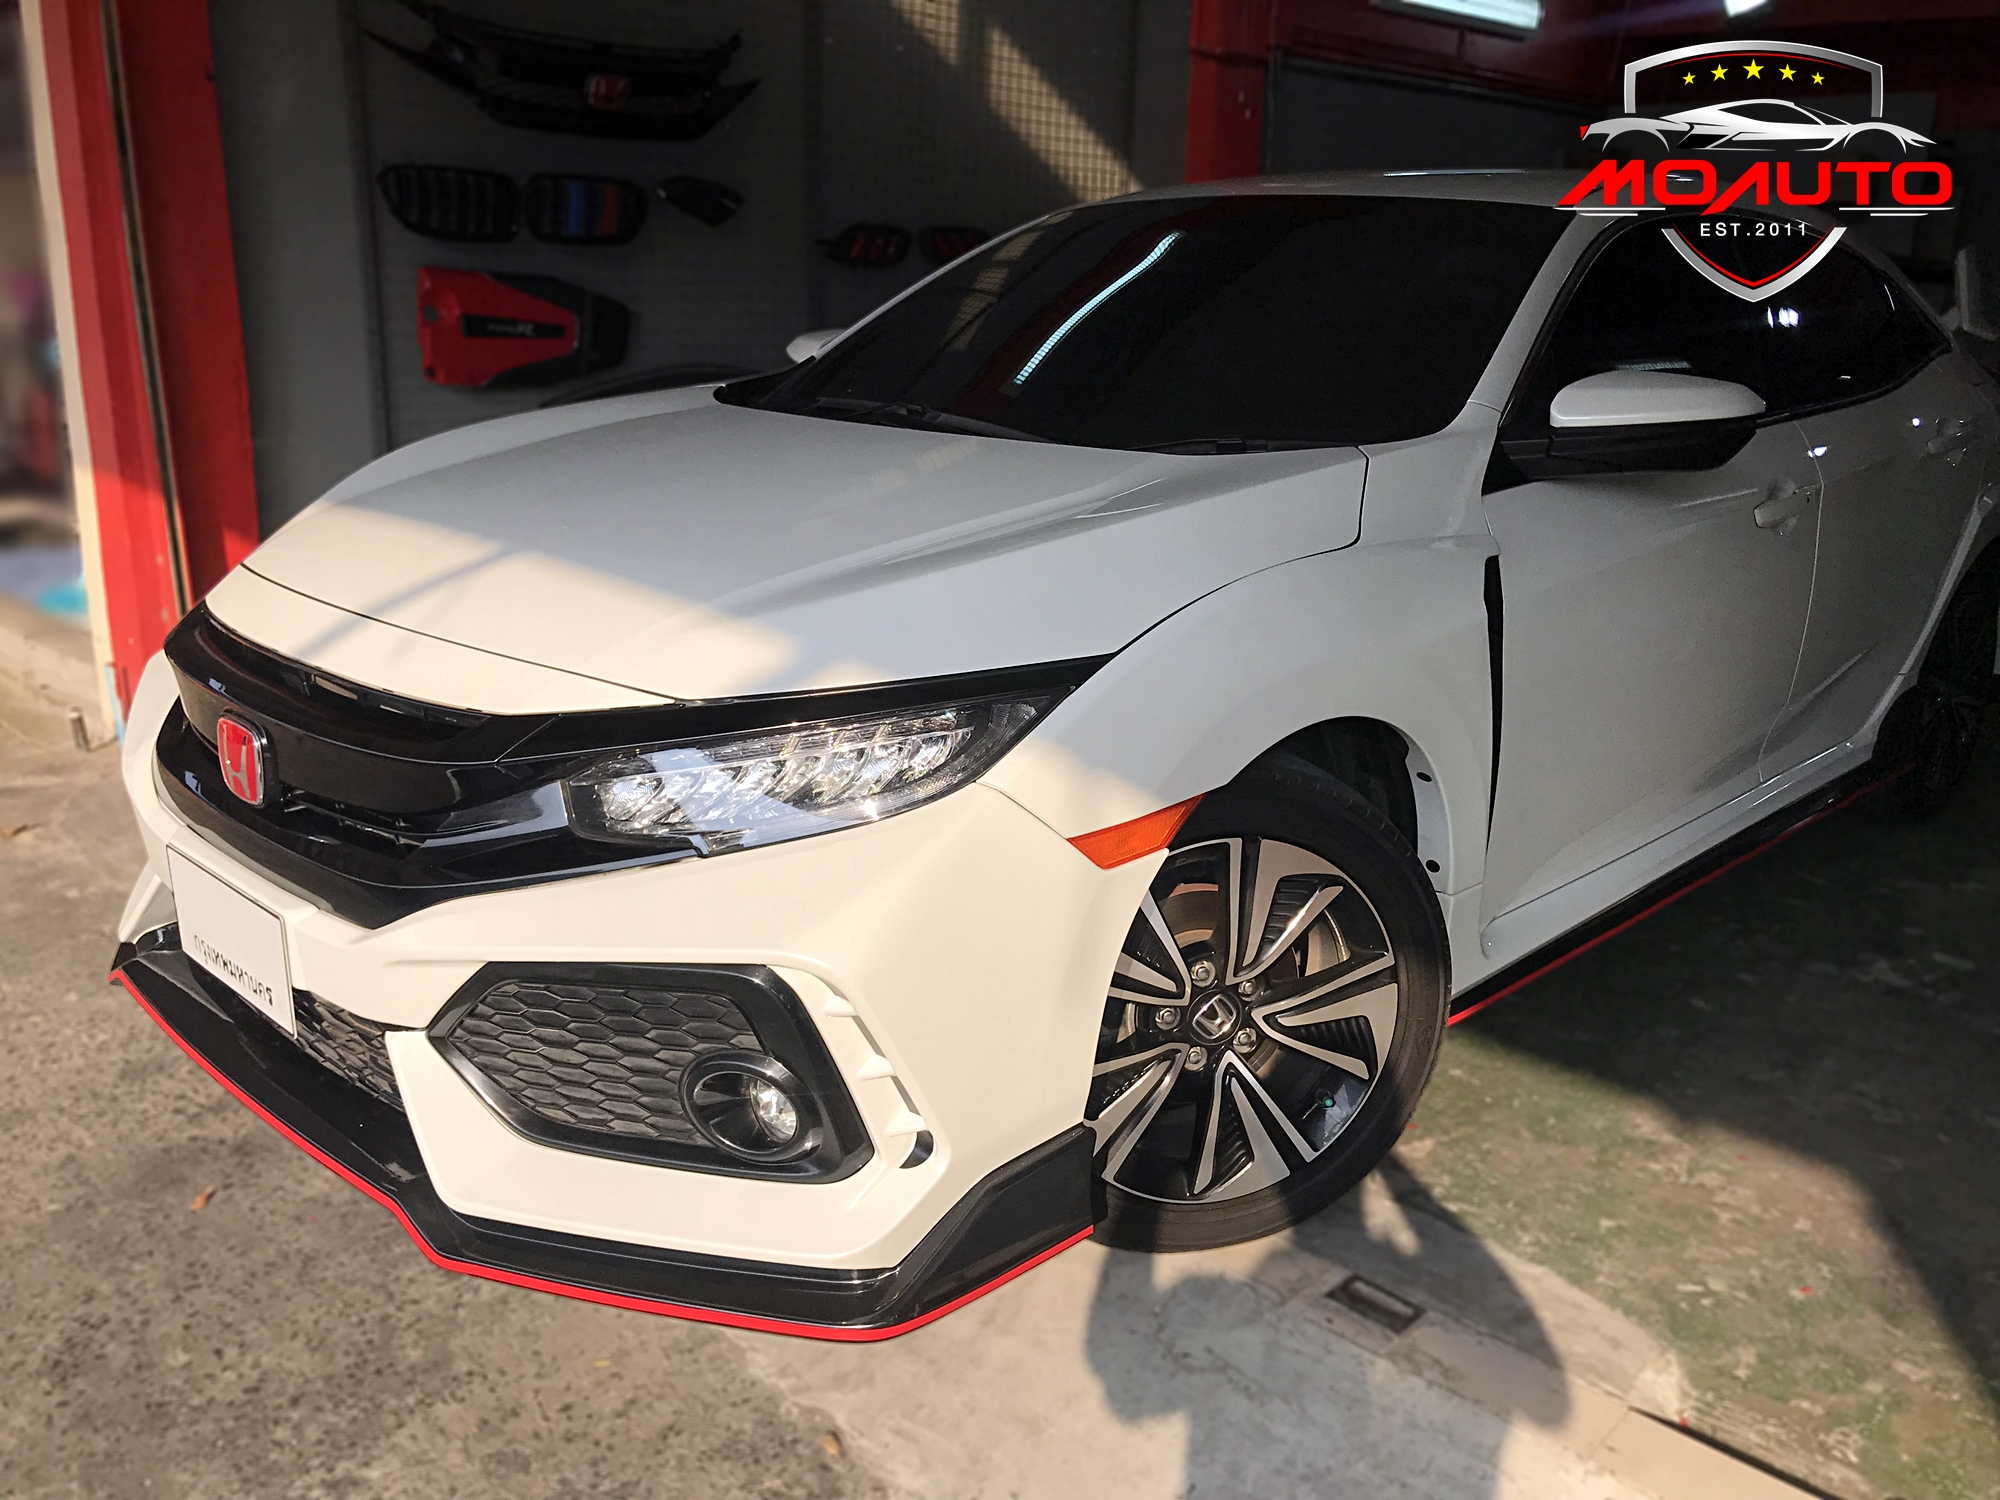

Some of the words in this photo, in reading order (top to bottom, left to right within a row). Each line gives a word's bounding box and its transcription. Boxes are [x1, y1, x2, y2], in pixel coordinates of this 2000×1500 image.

[194, 934, 273, 1006] กรุงเทพมหานคร
